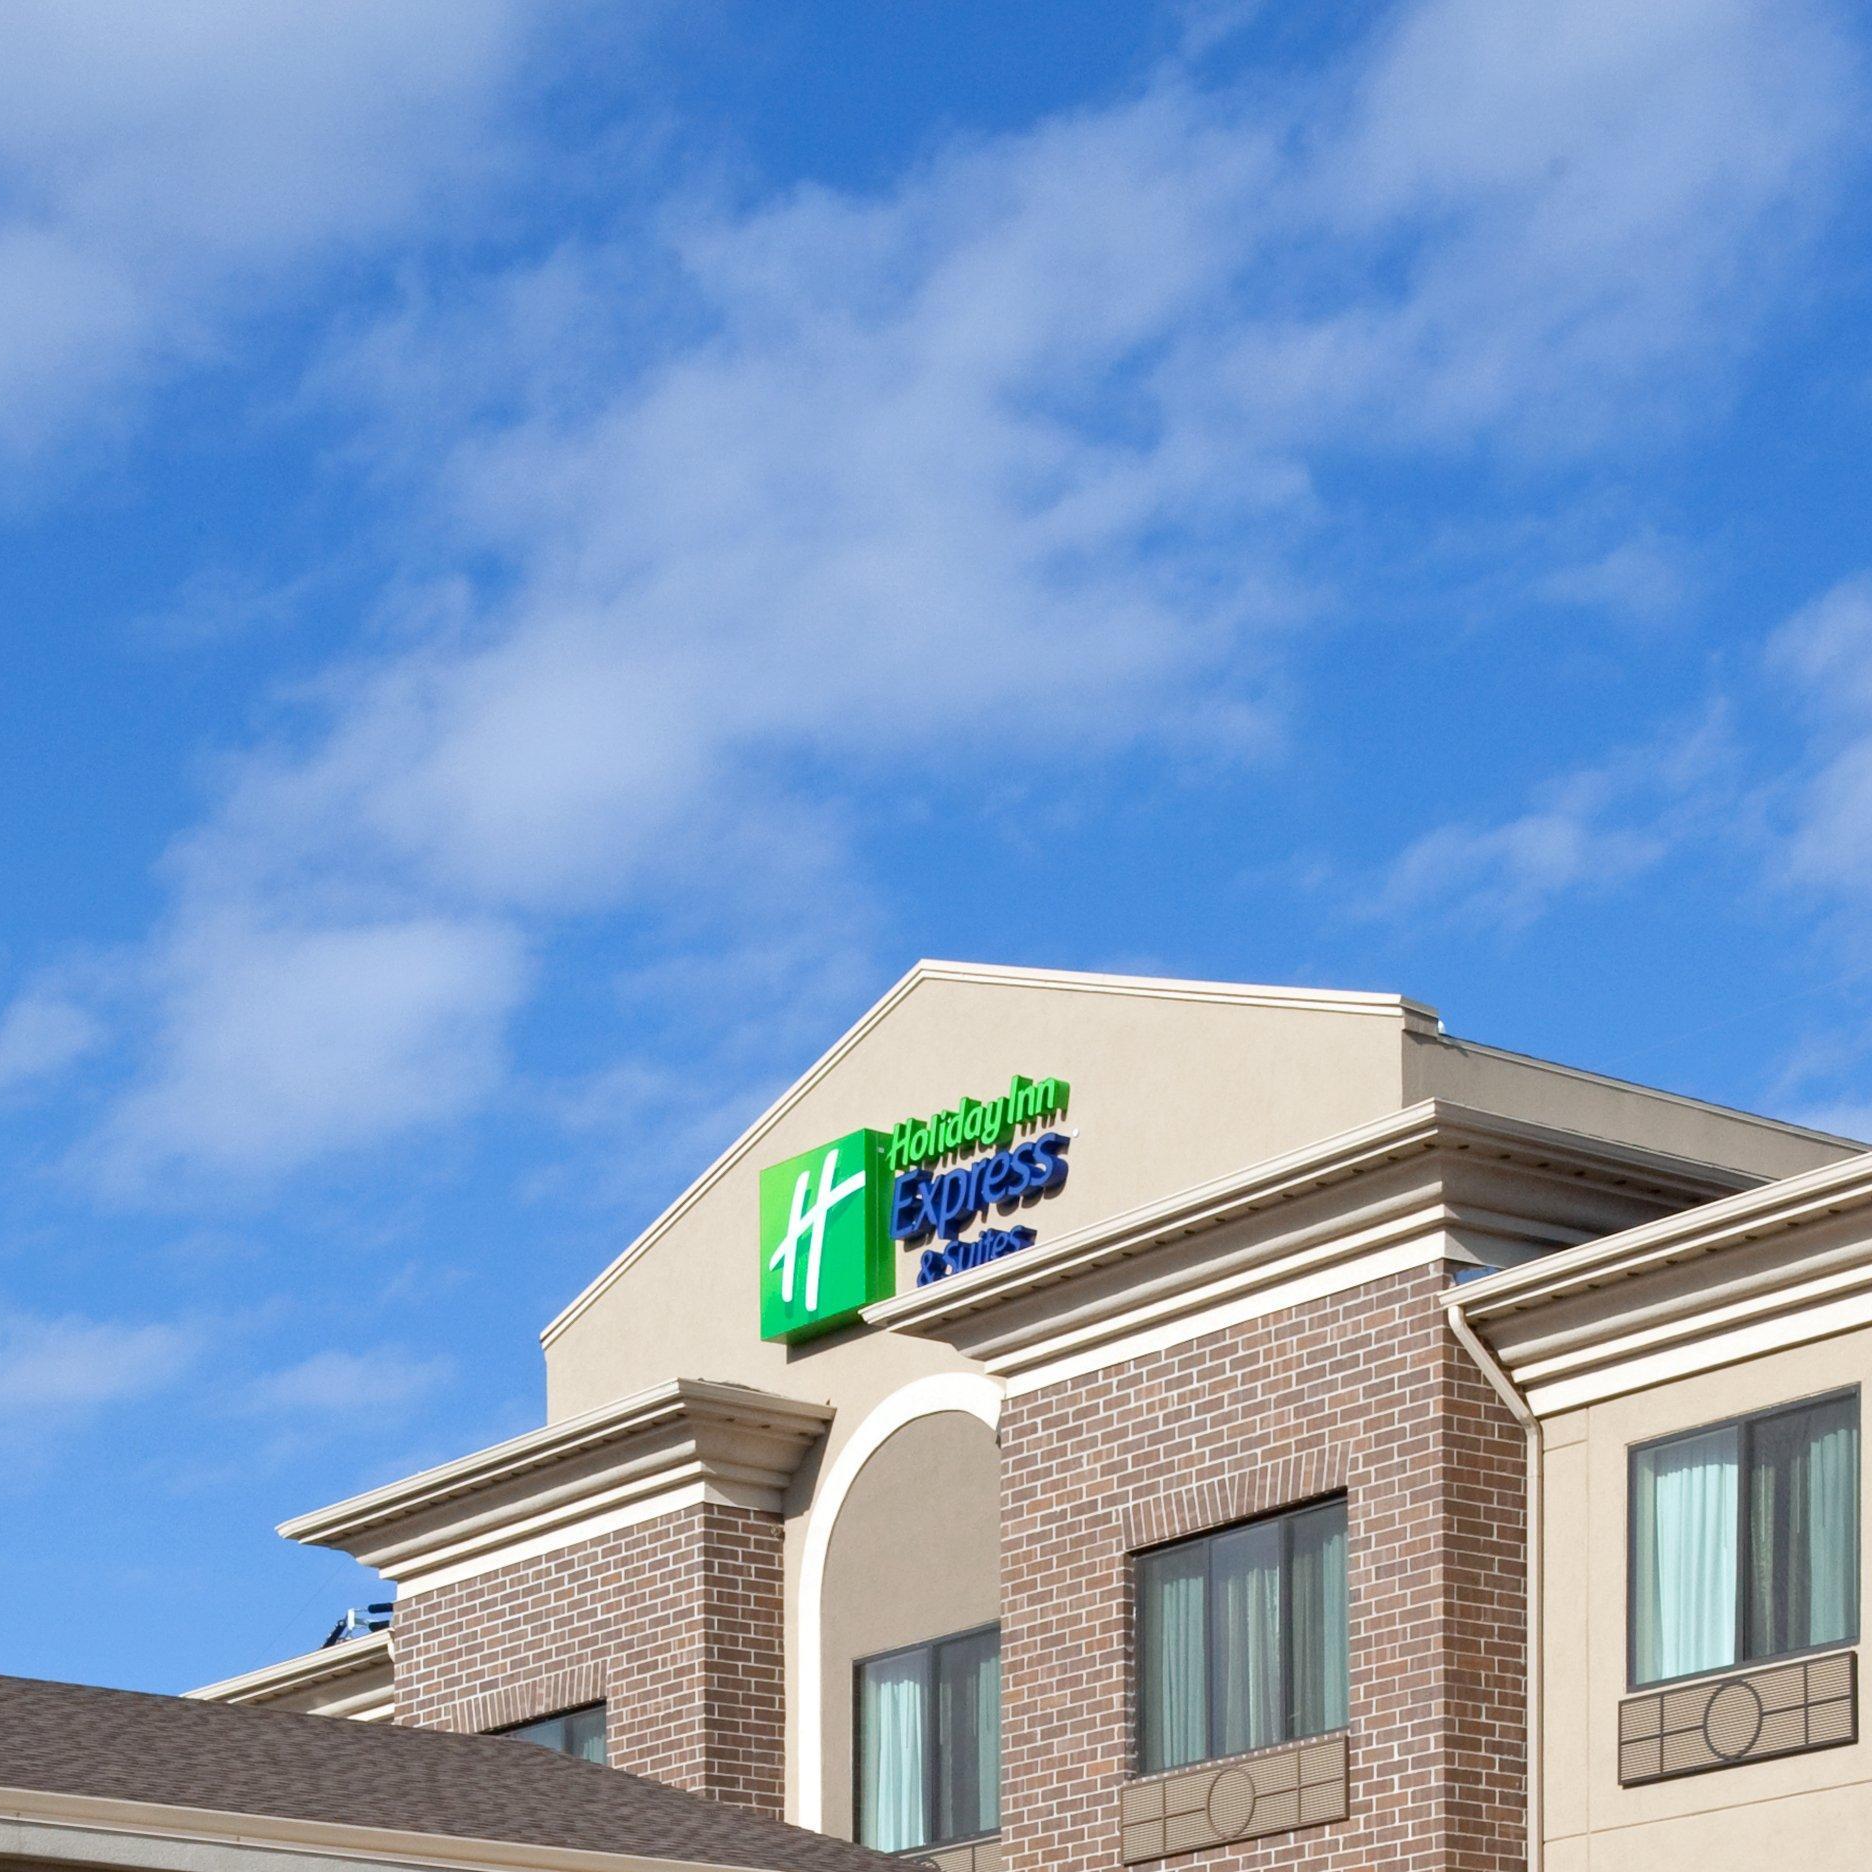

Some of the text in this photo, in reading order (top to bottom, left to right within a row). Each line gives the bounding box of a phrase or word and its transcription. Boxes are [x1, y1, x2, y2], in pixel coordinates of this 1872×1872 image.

[886, 1074, 1068, 1171] Holiday Inn
[889, 1132, 1070, 1240] Express
[917, 1224, 1037, 1288] & Suites
